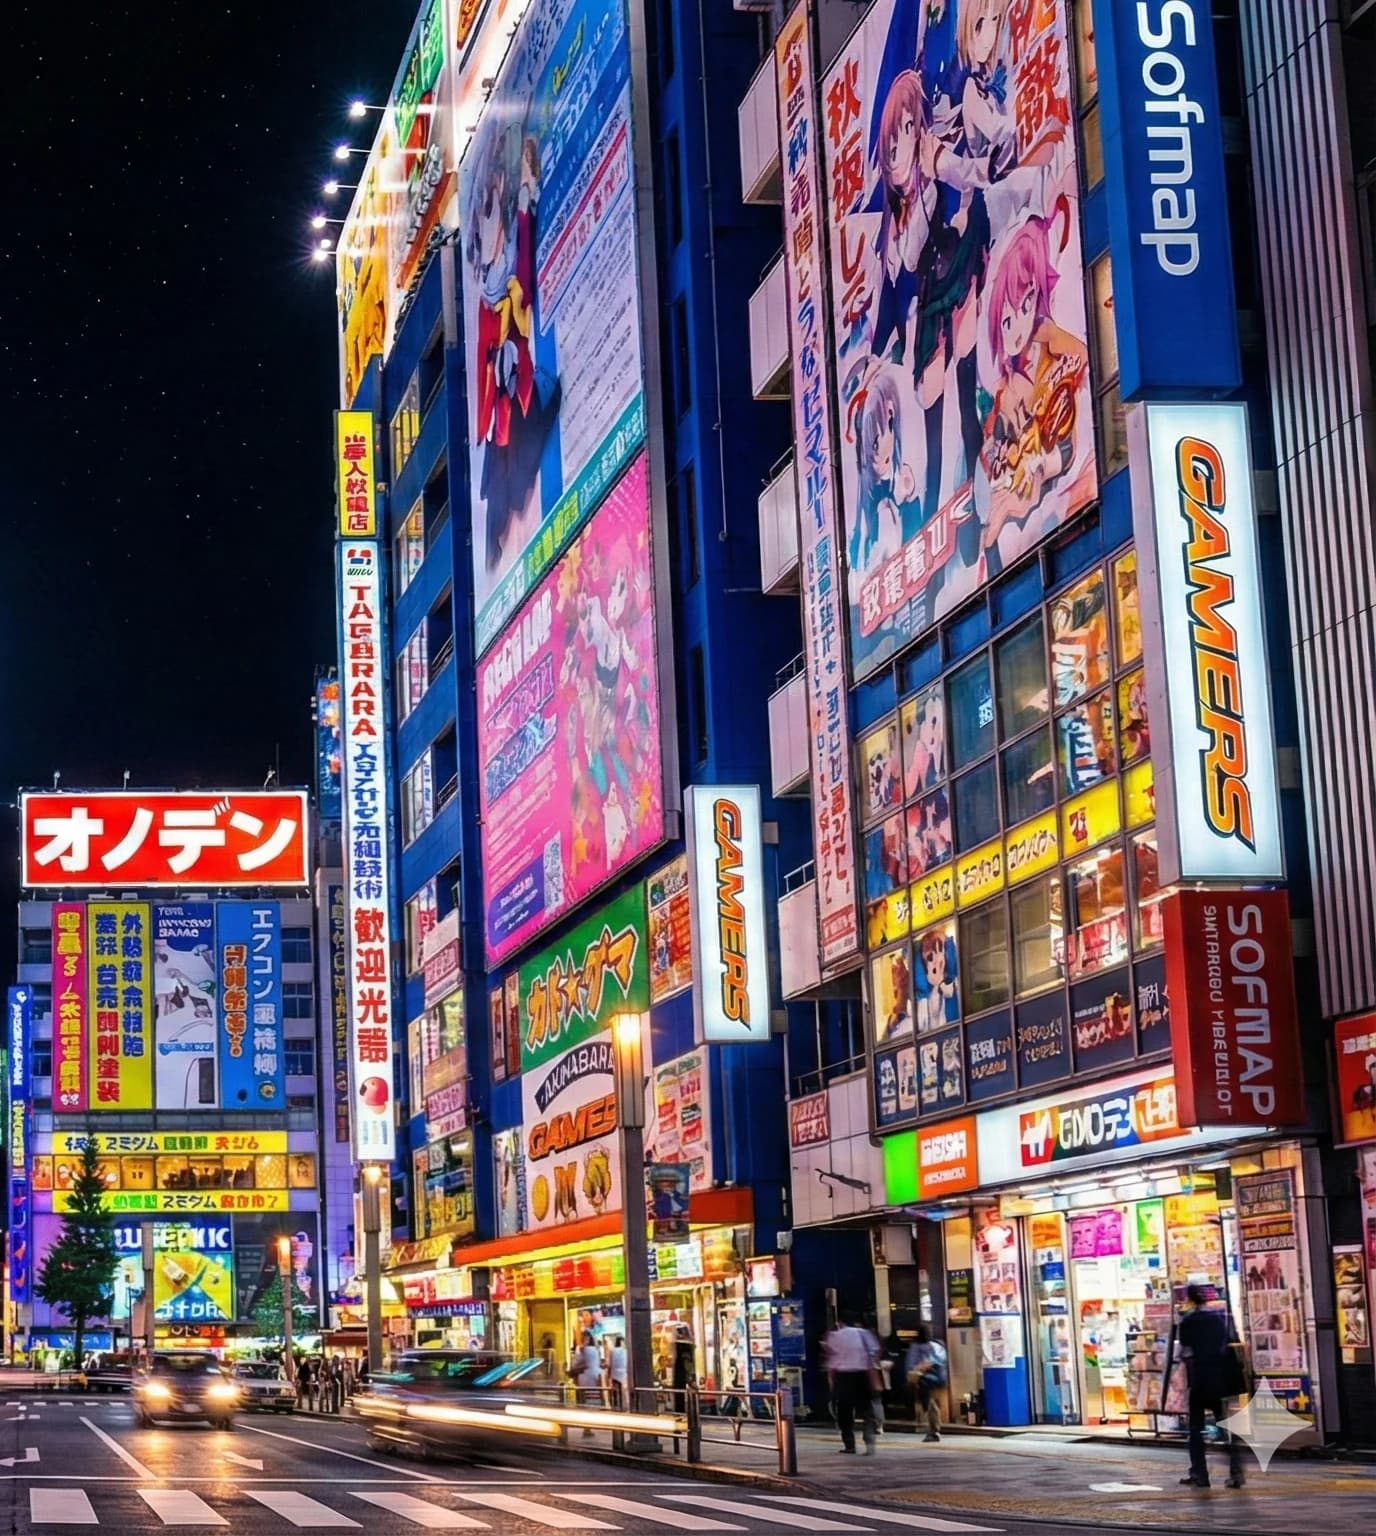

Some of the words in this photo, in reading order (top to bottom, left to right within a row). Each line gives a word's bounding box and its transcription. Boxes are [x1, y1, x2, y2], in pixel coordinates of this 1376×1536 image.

[1136, 0, 1205, 277] Sofmap
[1175, 436, 1257, 855] GAMERS
[33, 795, 297, 874] オノデン
[712, 798, 752, 1031] GAMERS
[1227, 904, 1275, 1117] SOFMAP
